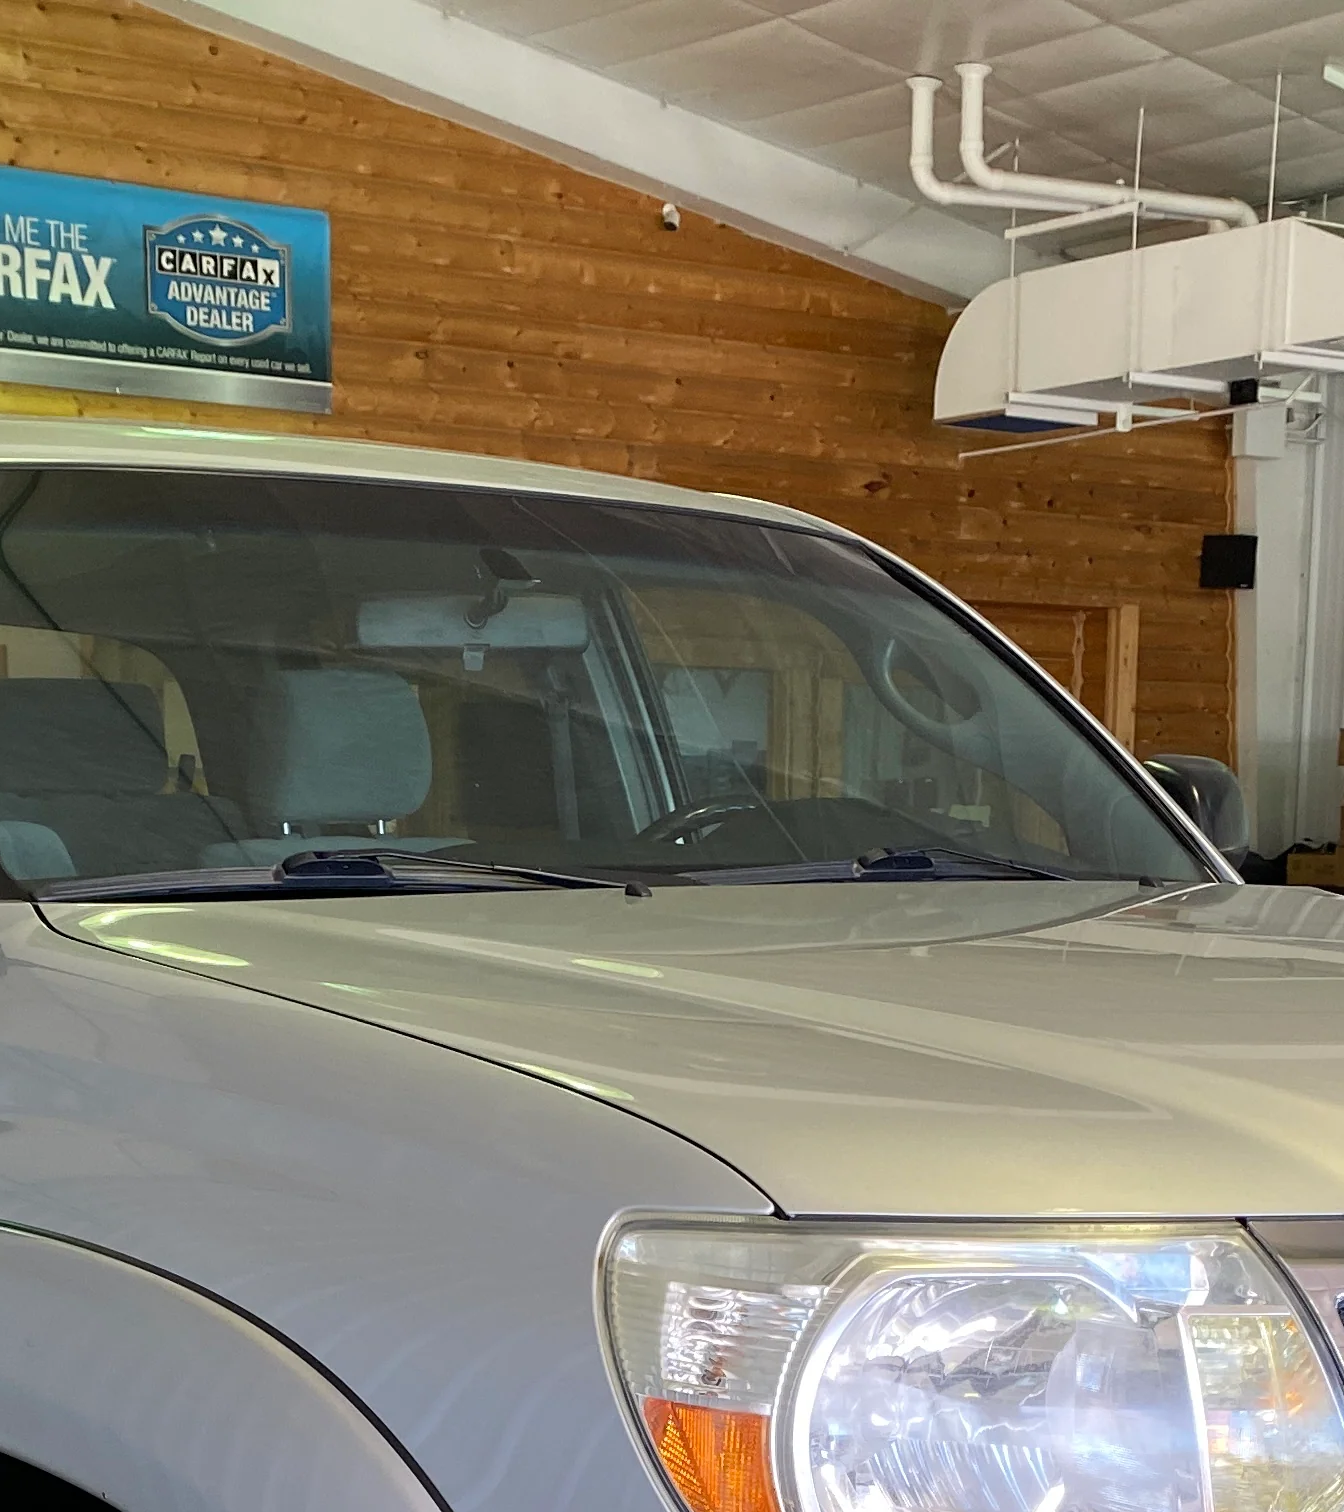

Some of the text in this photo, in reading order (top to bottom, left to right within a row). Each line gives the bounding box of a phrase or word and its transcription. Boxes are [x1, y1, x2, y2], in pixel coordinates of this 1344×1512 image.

[6, 214, 41, 246] ME
[45, 219, 88, 252] THE
[160, 250, 275, 285] CARFAX
[167, 280, 271, 312] ADVANTAGE
[186, 305, 254, 333] DEALER
